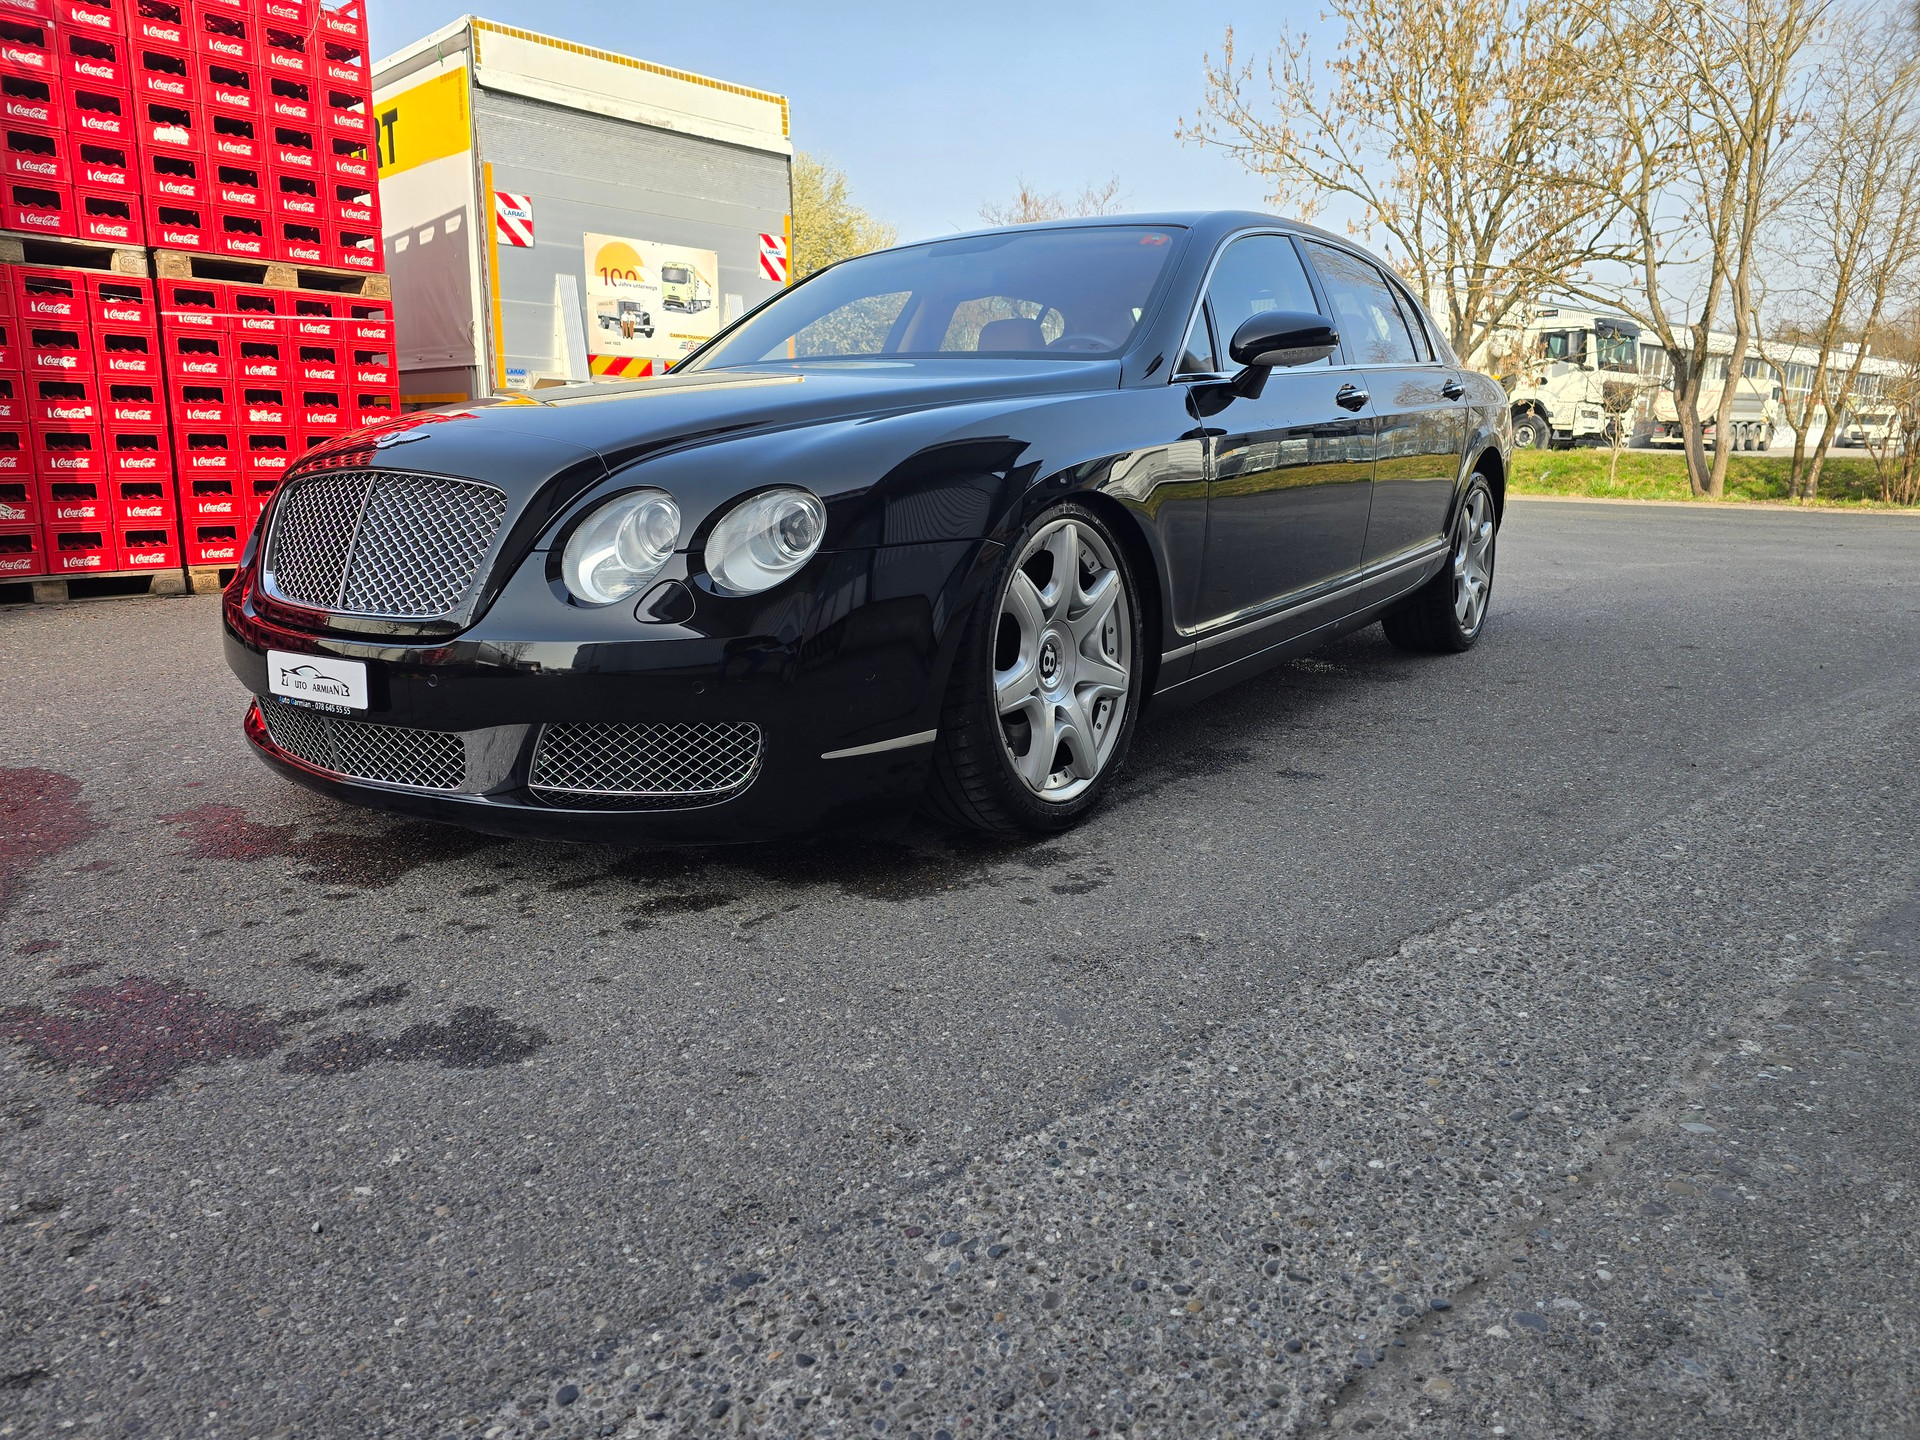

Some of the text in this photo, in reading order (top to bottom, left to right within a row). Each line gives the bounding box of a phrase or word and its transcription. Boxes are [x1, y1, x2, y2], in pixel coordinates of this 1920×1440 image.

[503, 209, 525, 218] LARAG
[633, 283, 658, 291] unterwegs
[279, 696, 290, 704] Auto
[291, 698, 311, 708] Garmian
[315, 702, 325, 711] 078
[325, 704, 335, 713] 645
[336, 706, 343, 714] 55
[344, 707, 351, 715] 55
